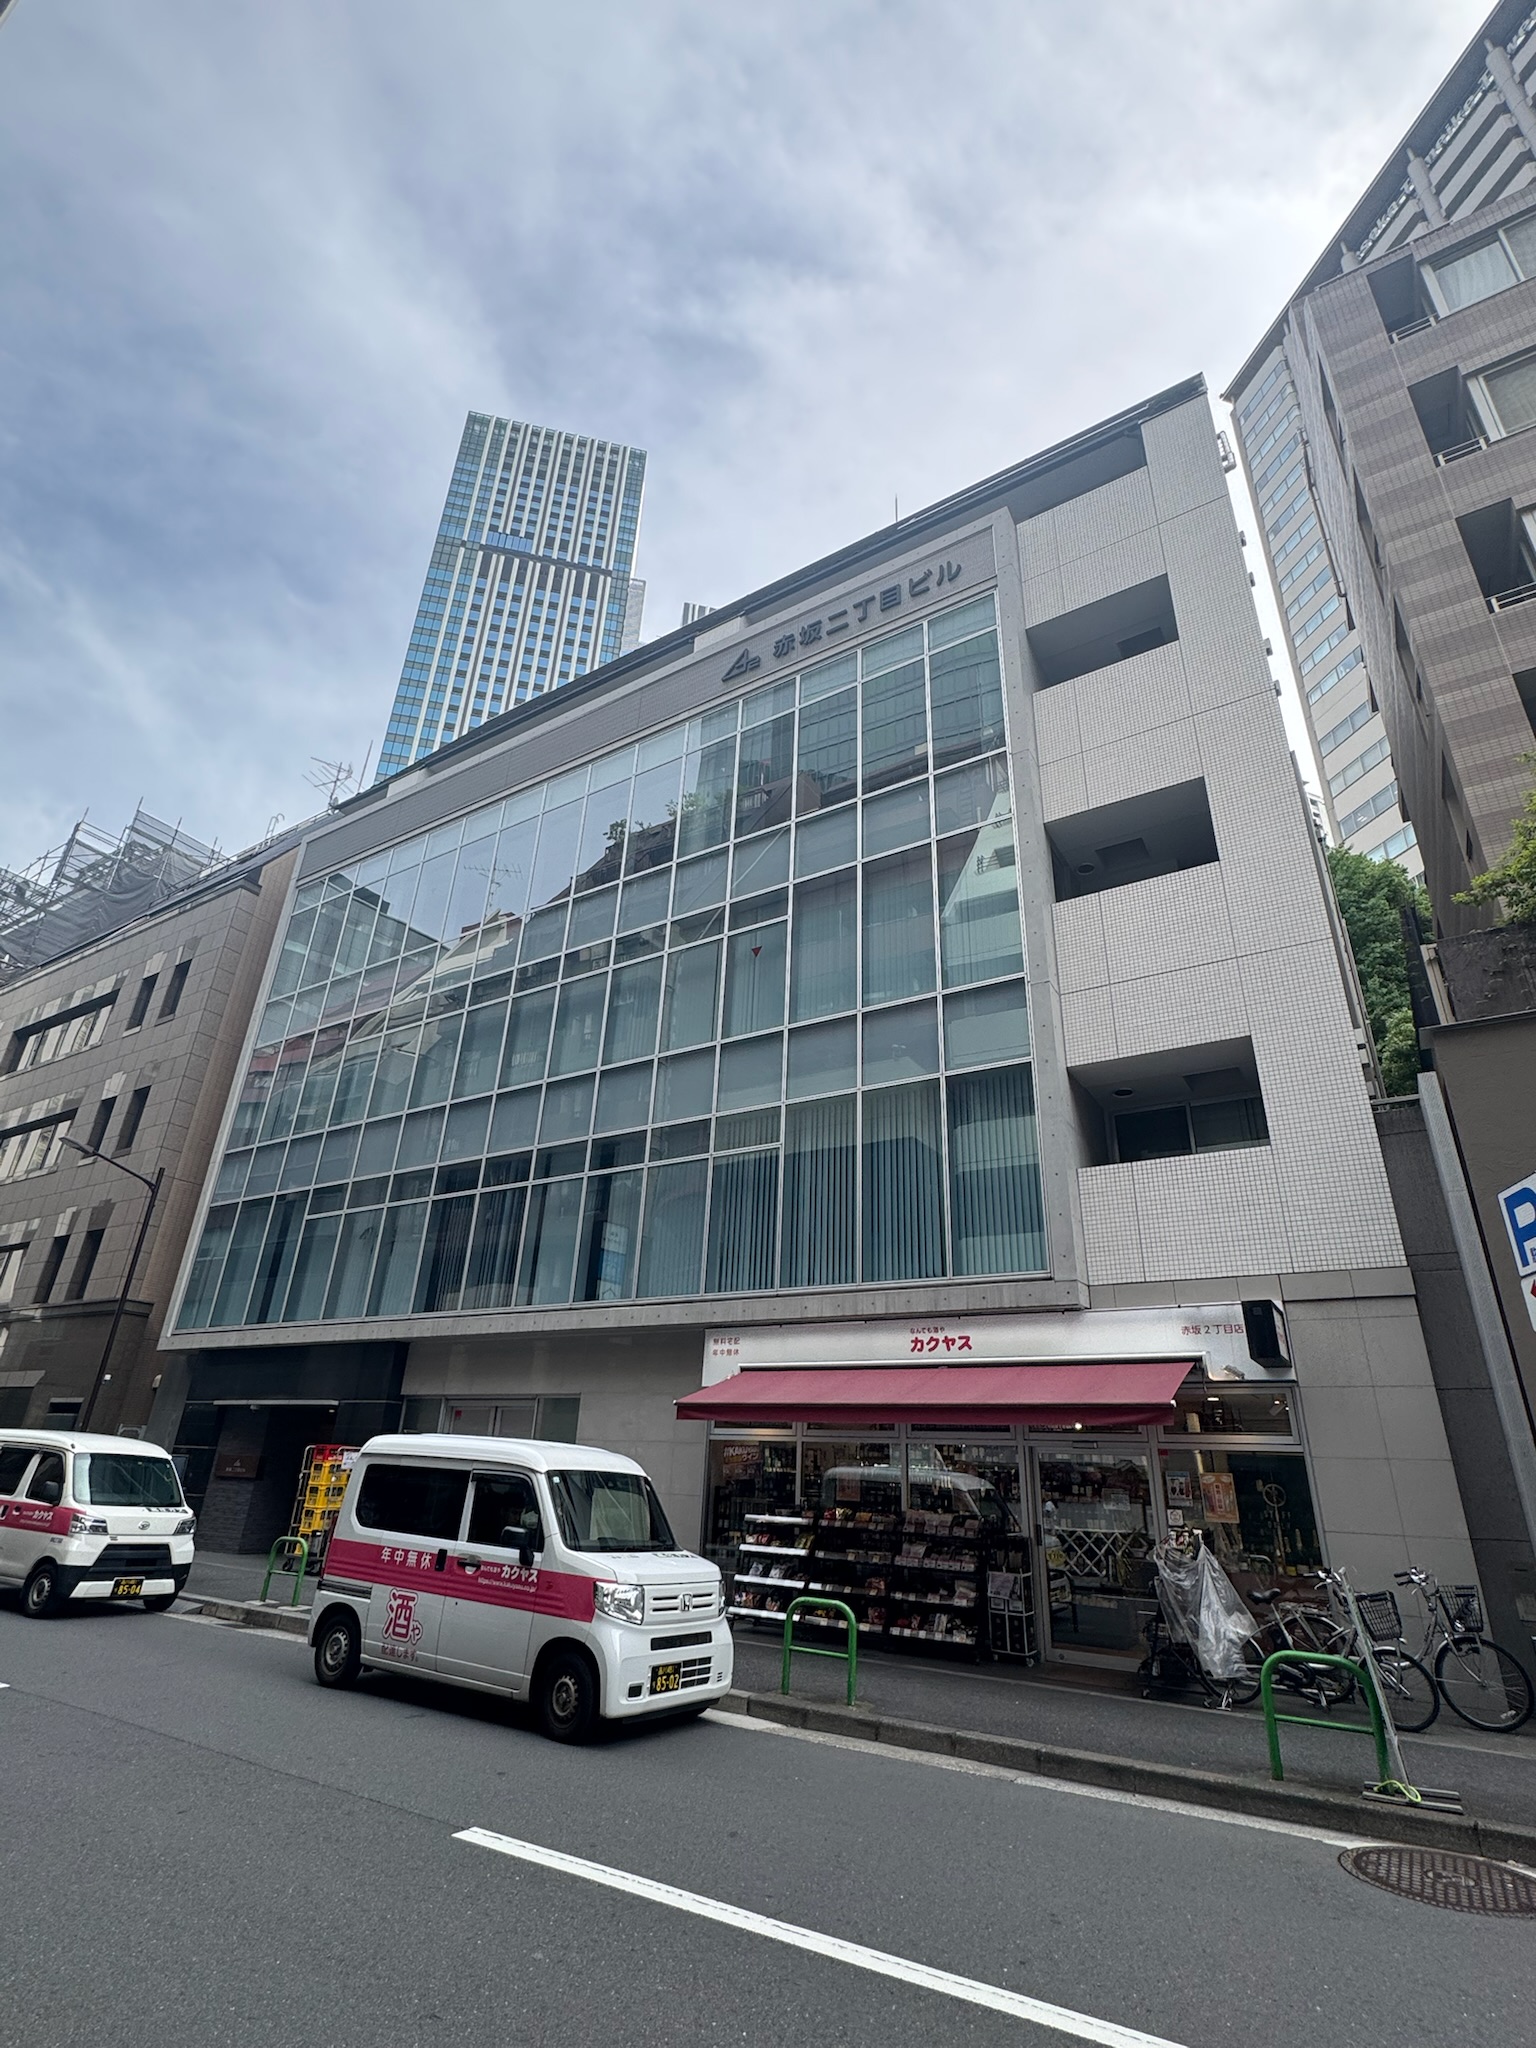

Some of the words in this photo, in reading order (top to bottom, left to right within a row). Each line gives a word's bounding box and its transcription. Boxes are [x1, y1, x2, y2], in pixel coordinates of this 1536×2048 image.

[772, 560, 963, 658] 赤坂二丁目ビル
[1503, 1186, 1536, 1268] P
[910, 1335, 973, 1353] カクヤス
[32, 1510, 54, 1521] カクヤス
[381, 1546, 432, 1570] 年中無休
[501, 1564, 538, 1583] カクヤス
